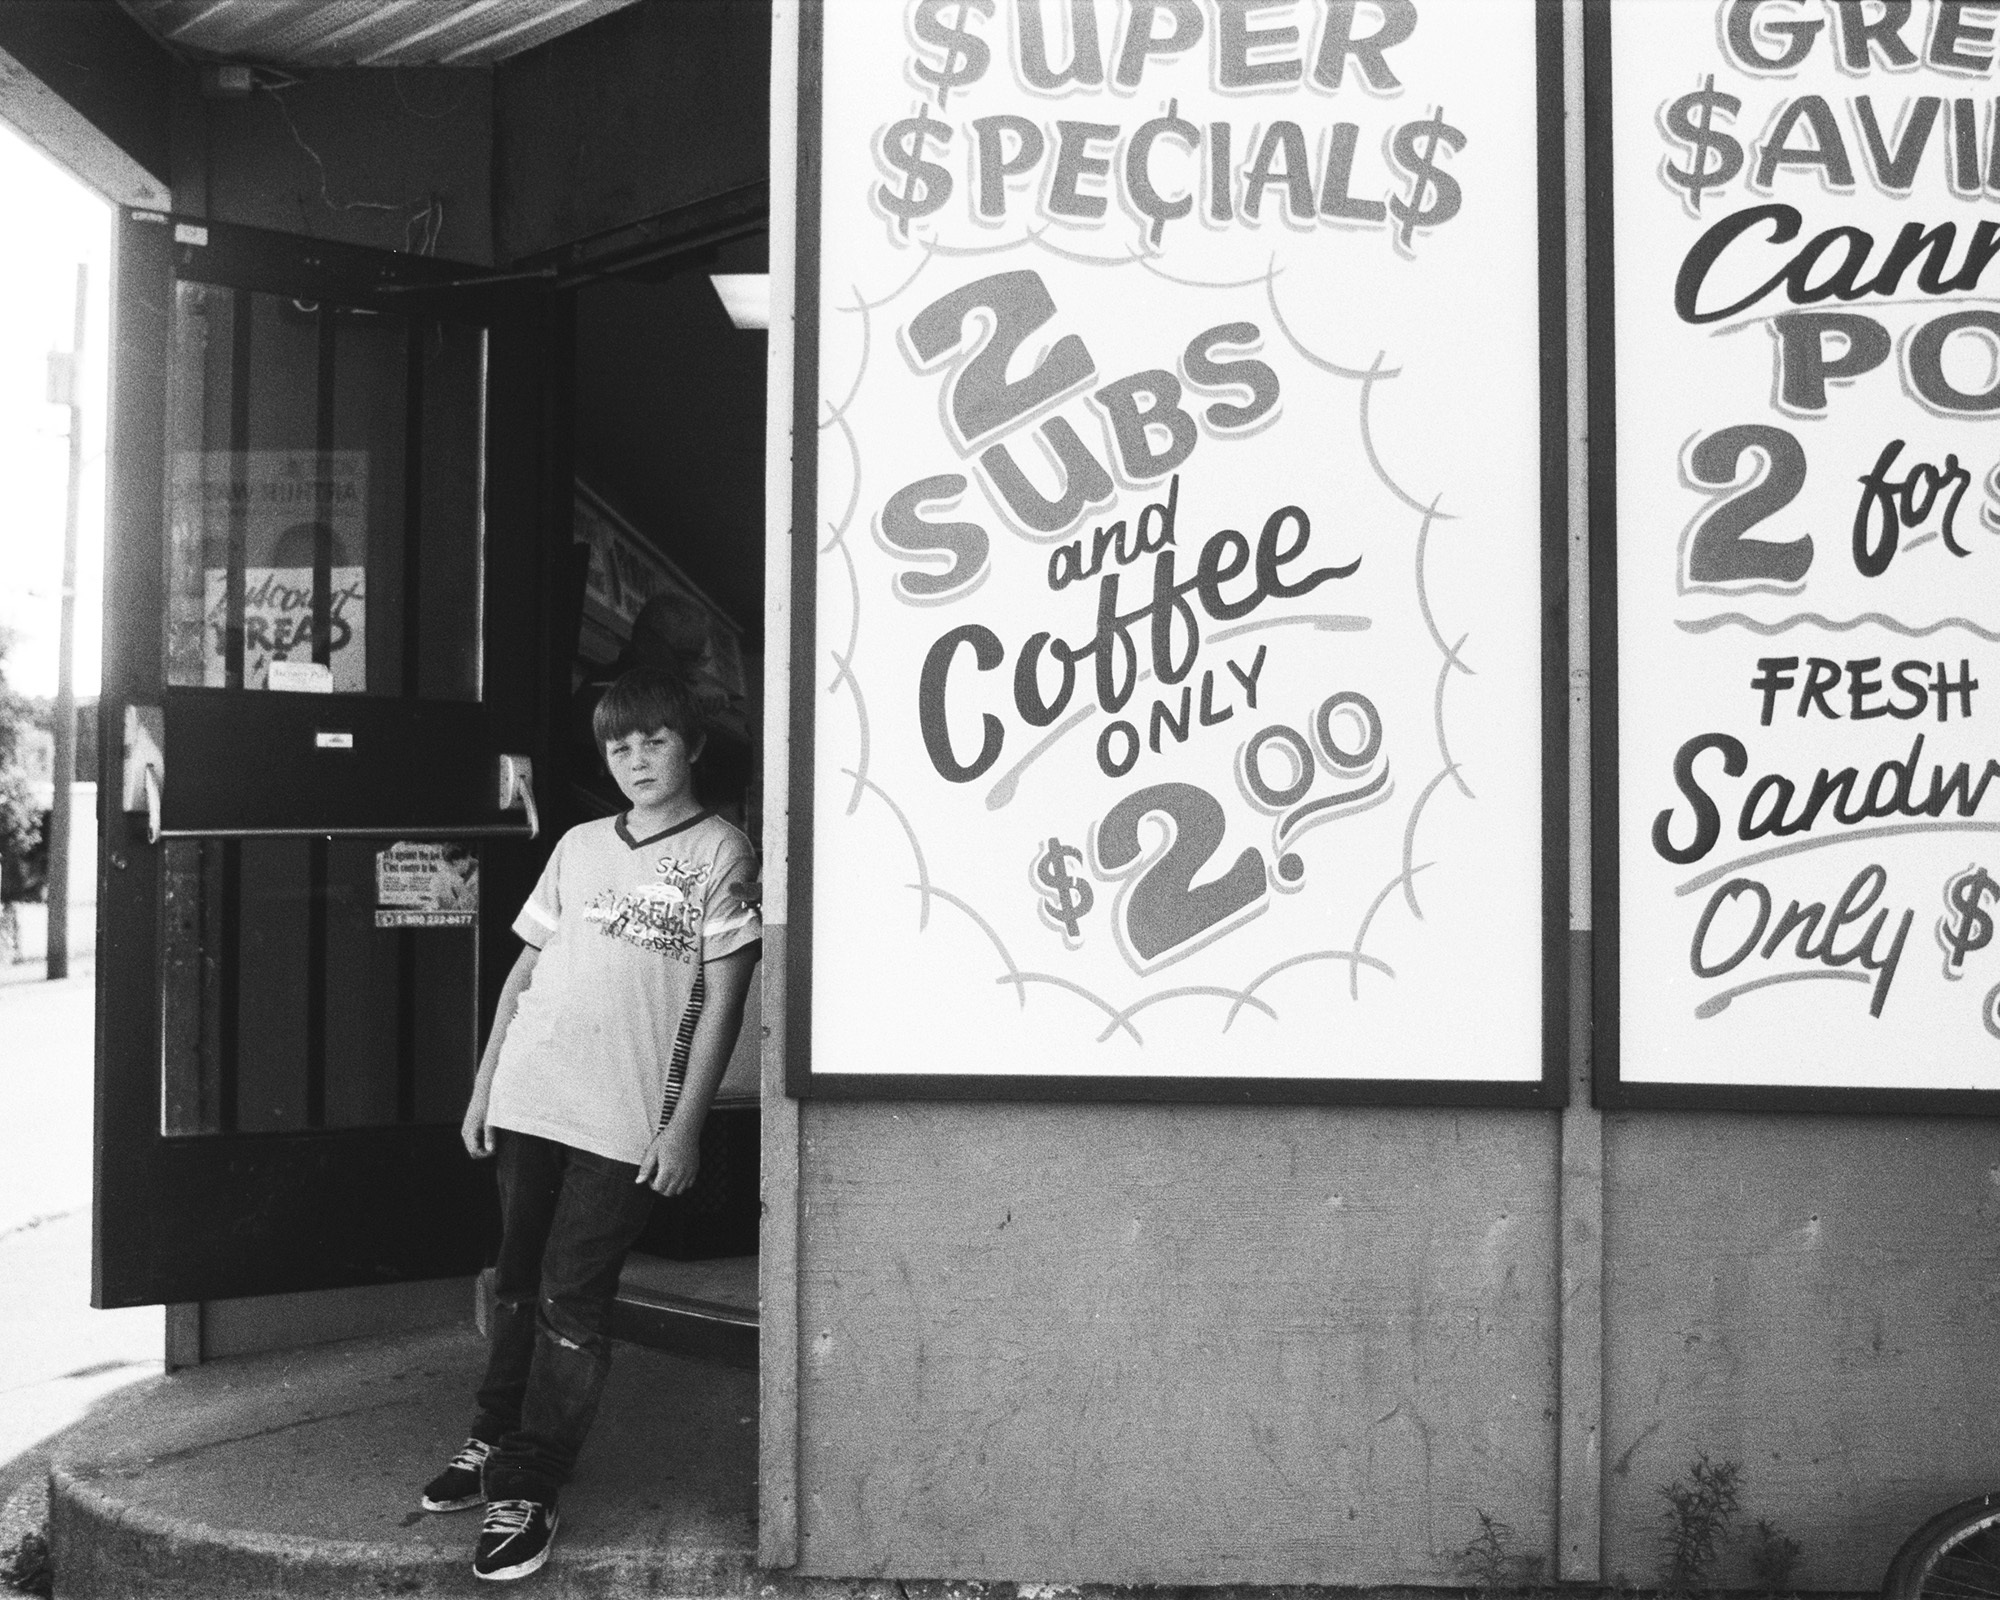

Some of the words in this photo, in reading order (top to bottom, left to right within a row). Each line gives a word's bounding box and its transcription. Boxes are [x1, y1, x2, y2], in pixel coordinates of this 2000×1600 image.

[1655, 74, 2000, 219] $AVI
[896, 268, 1100, 460] 2
[1766, 309, 2000, 420] PO
[871, 321, 1283, 607] SUBS
[1047, 473, 1179, 591] and
[1677, 423, 1815, 597] 2
[1852, 439, 1973, 578] for
[918, 504, 1363, 784] Coffee
[1097, 645, 1267, 778] ONLY
[1750, 655, 1979, 726] FRESH
[1651, 733, 2000, 864] Sandw
[1690, 864, 1915, 1019] Only
